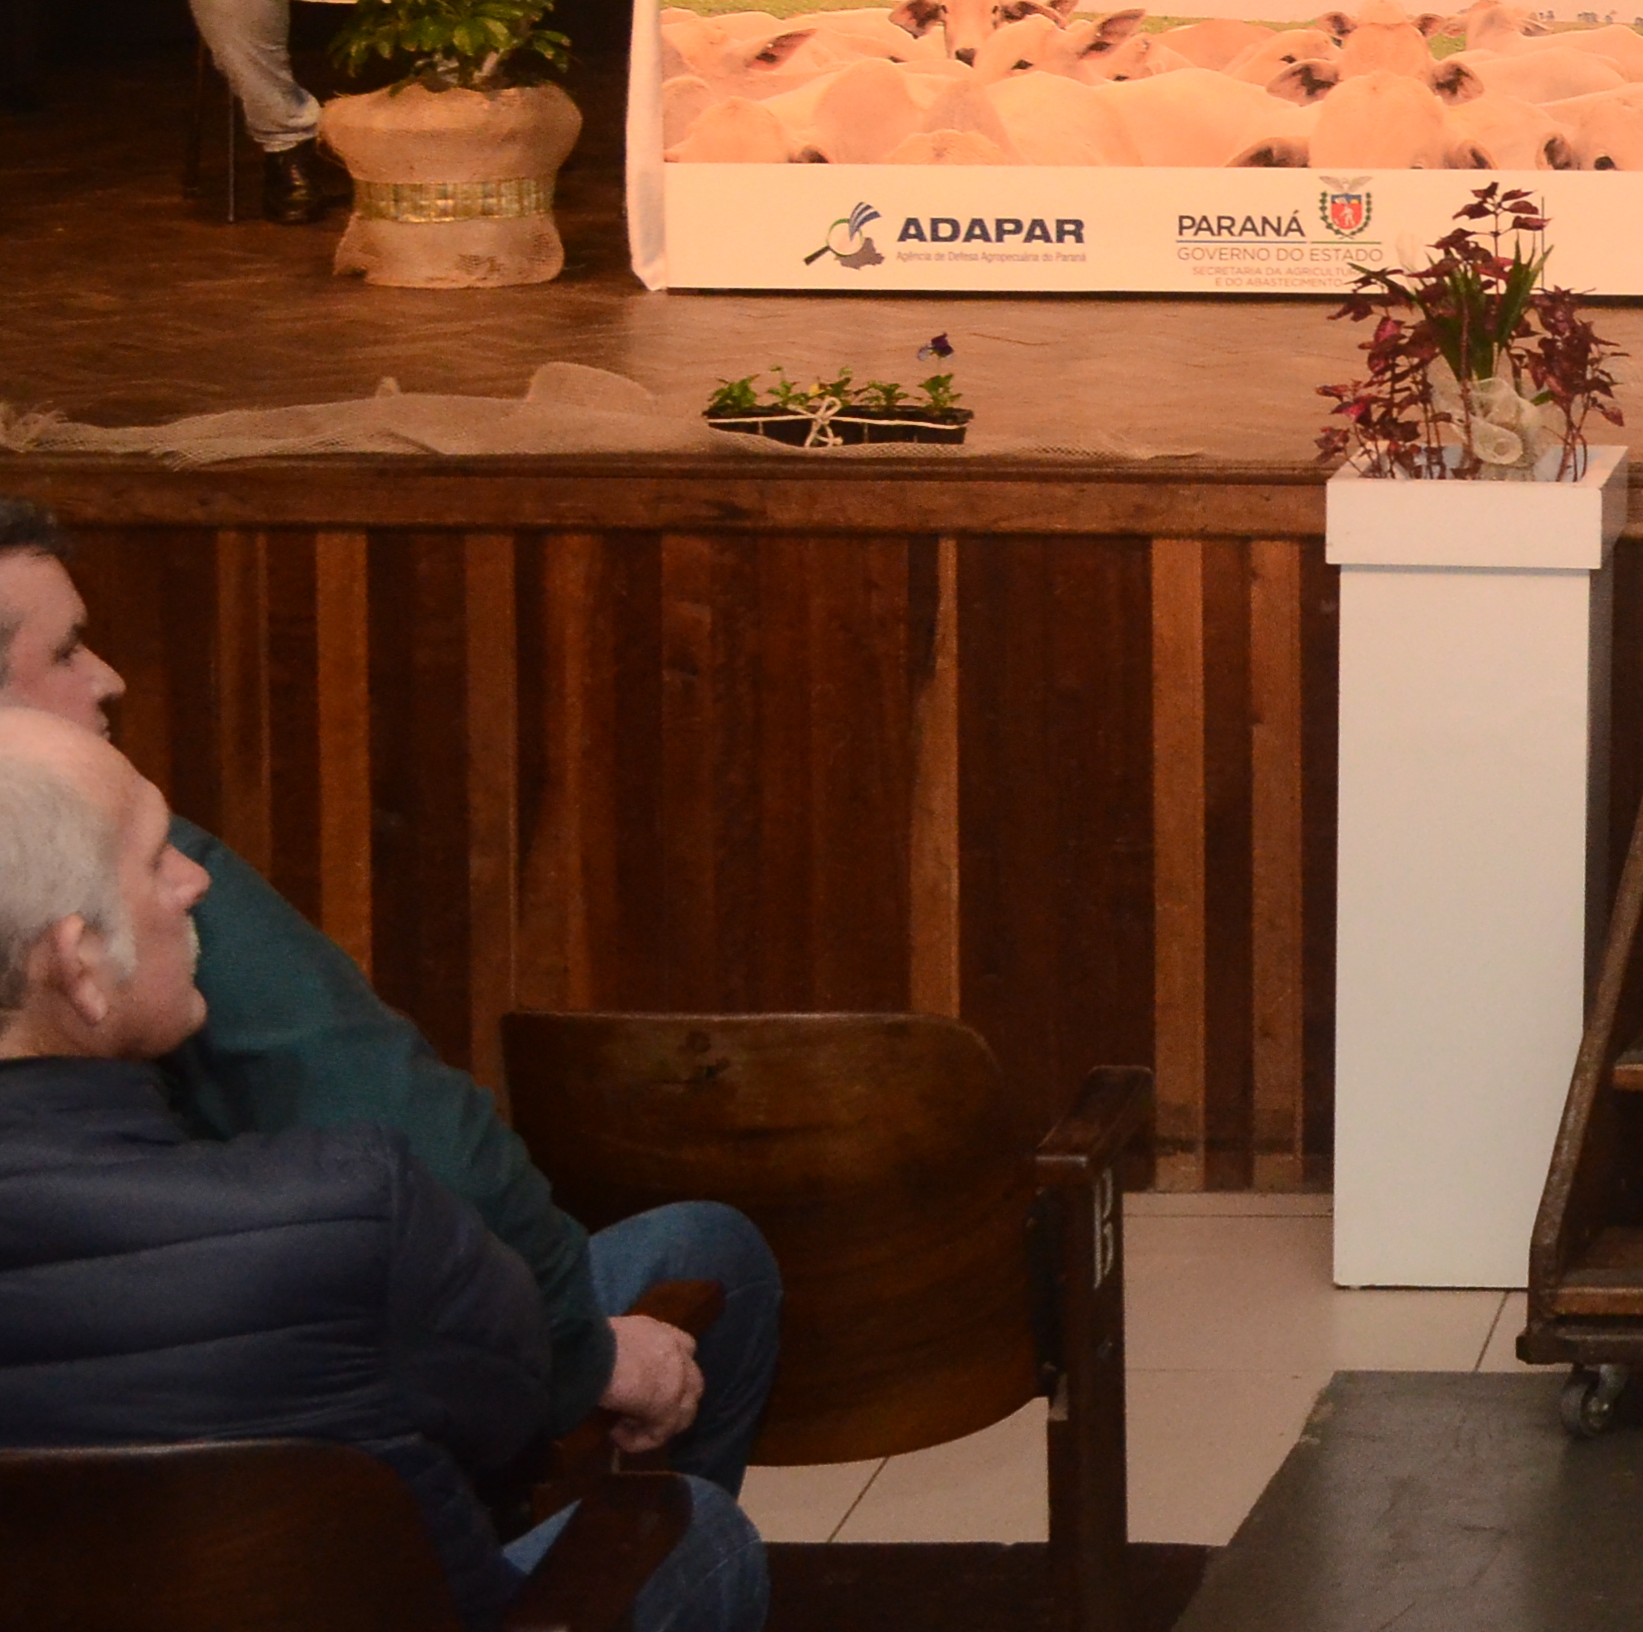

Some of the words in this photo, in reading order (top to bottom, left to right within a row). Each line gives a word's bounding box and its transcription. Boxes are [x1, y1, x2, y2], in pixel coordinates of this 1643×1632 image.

[1178, 209, 1306, 237] PARANÁ
[897, 217, 1085, 244] ADAPAR
[934, 252, 946, 261] de
[1177, 247, 1270, 261] GOVERNO
[1276, 247, 1304, 261] DO
[1310, 248, 1383, 262] ESTADO
[1192, 266, 1262, 276] SECRETARIA
[1266, 267, 1283, 276] DA
[1215, 278, 1221, 287] E
[1225, 278, 1243, 287] DO
[1245, 278, 1344, 287] ABASTECIMENTO
